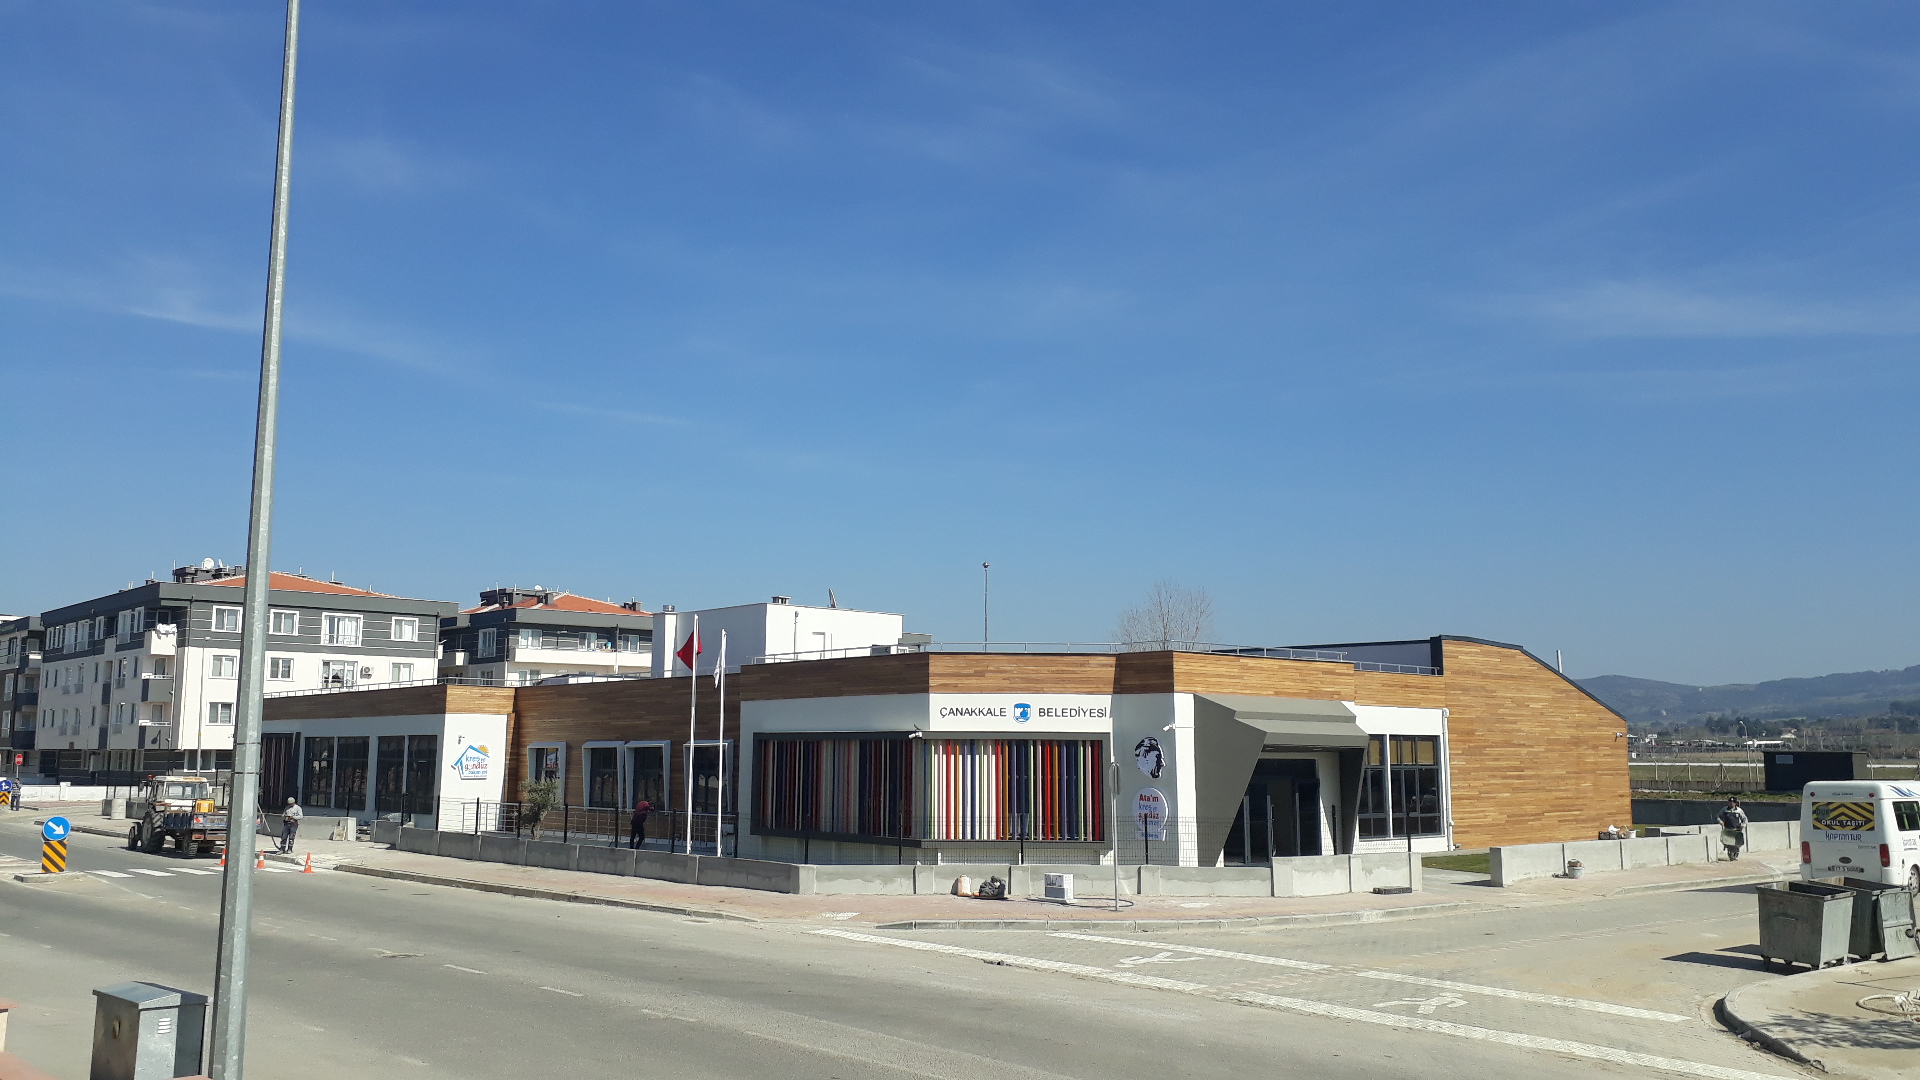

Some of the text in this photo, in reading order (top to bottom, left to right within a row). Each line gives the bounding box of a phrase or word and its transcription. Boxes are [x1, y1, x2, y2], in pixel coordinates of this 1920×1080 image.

[939, 706, 1107, 719] ÇANAKKALE BELEDİYESİ
[1139, 793, 1159, 803] Ata'm
